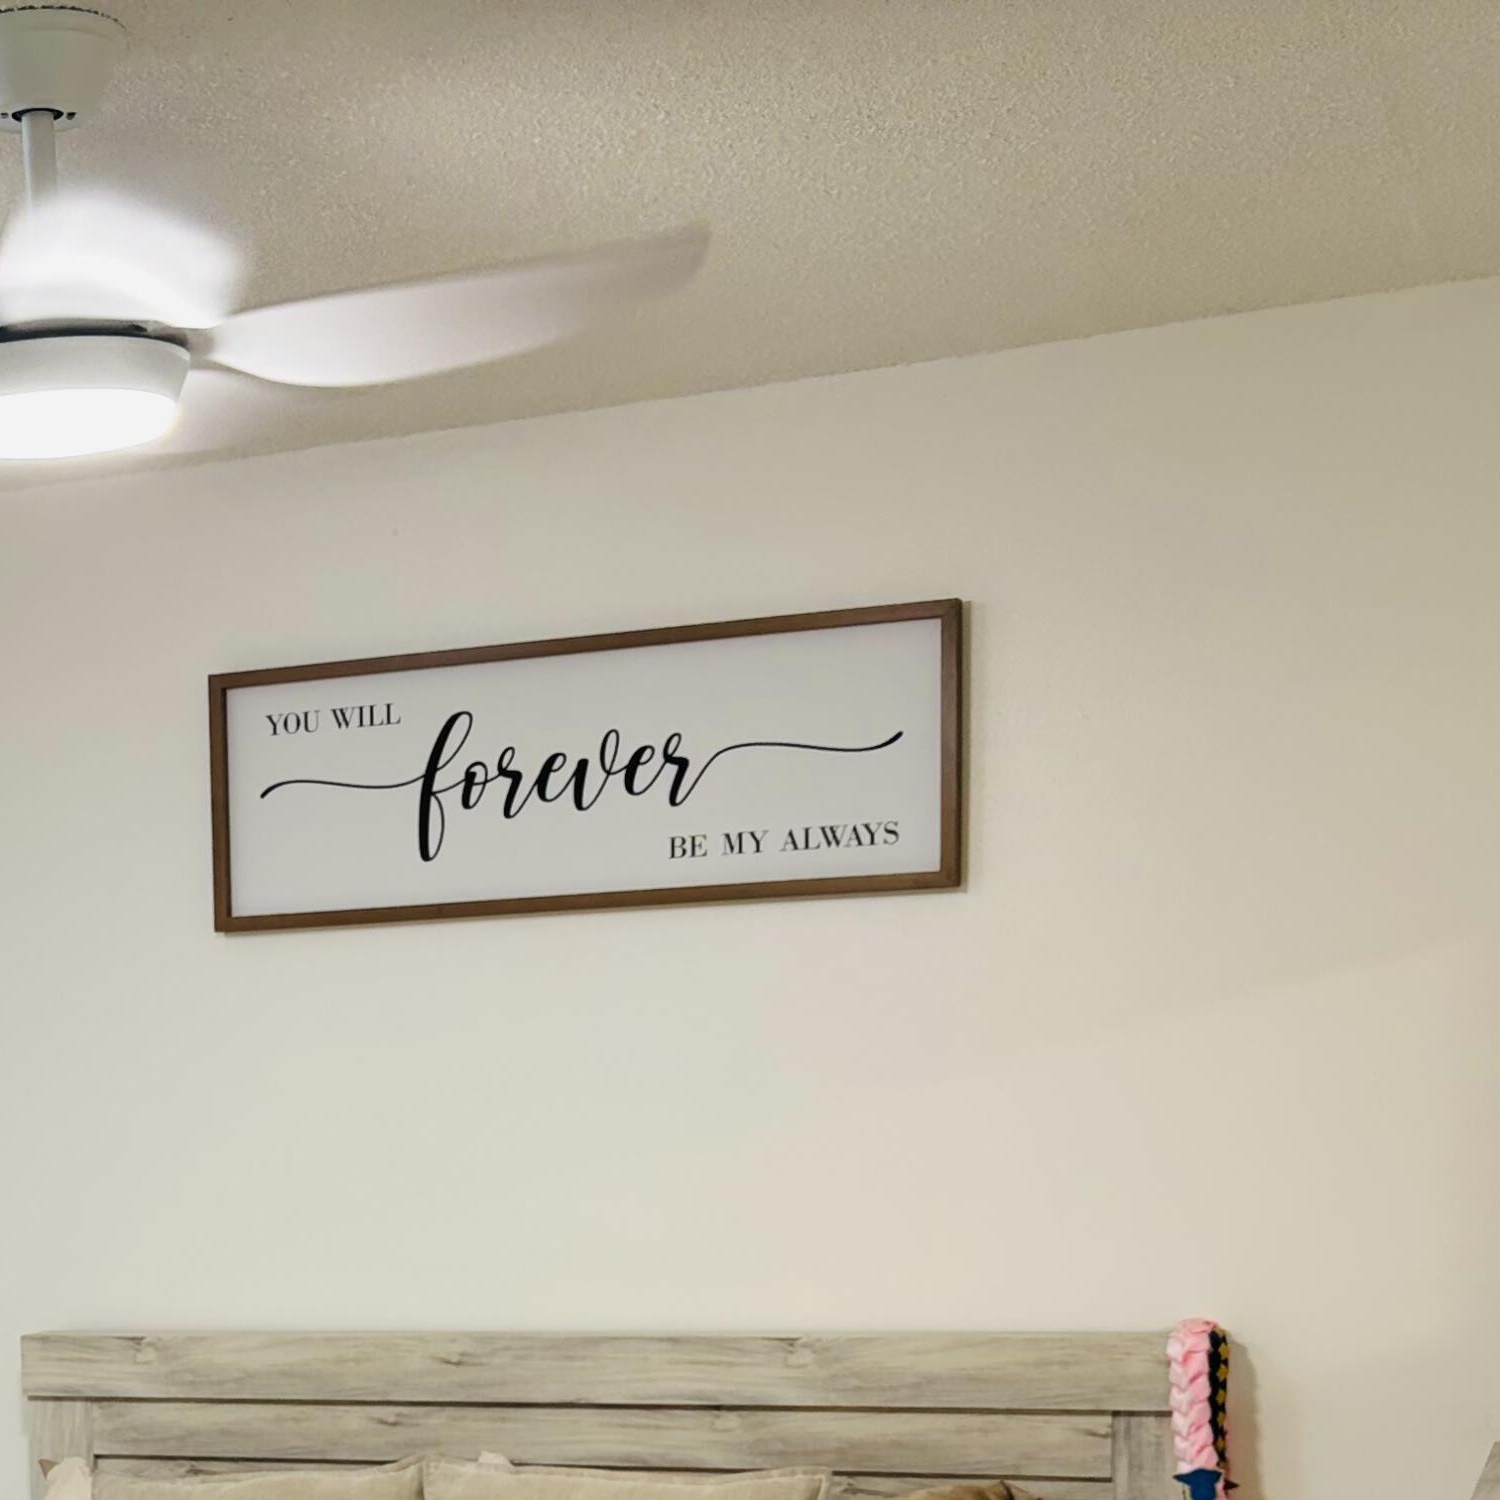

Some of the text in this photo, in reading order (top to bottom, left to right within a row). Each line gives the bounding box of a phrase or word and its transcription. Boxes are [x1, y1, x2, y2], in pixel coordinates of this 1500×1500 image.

[265, 703, 401, 737] YOU WILL
[669, 821, 900, 859] BE MY ALWAYS
